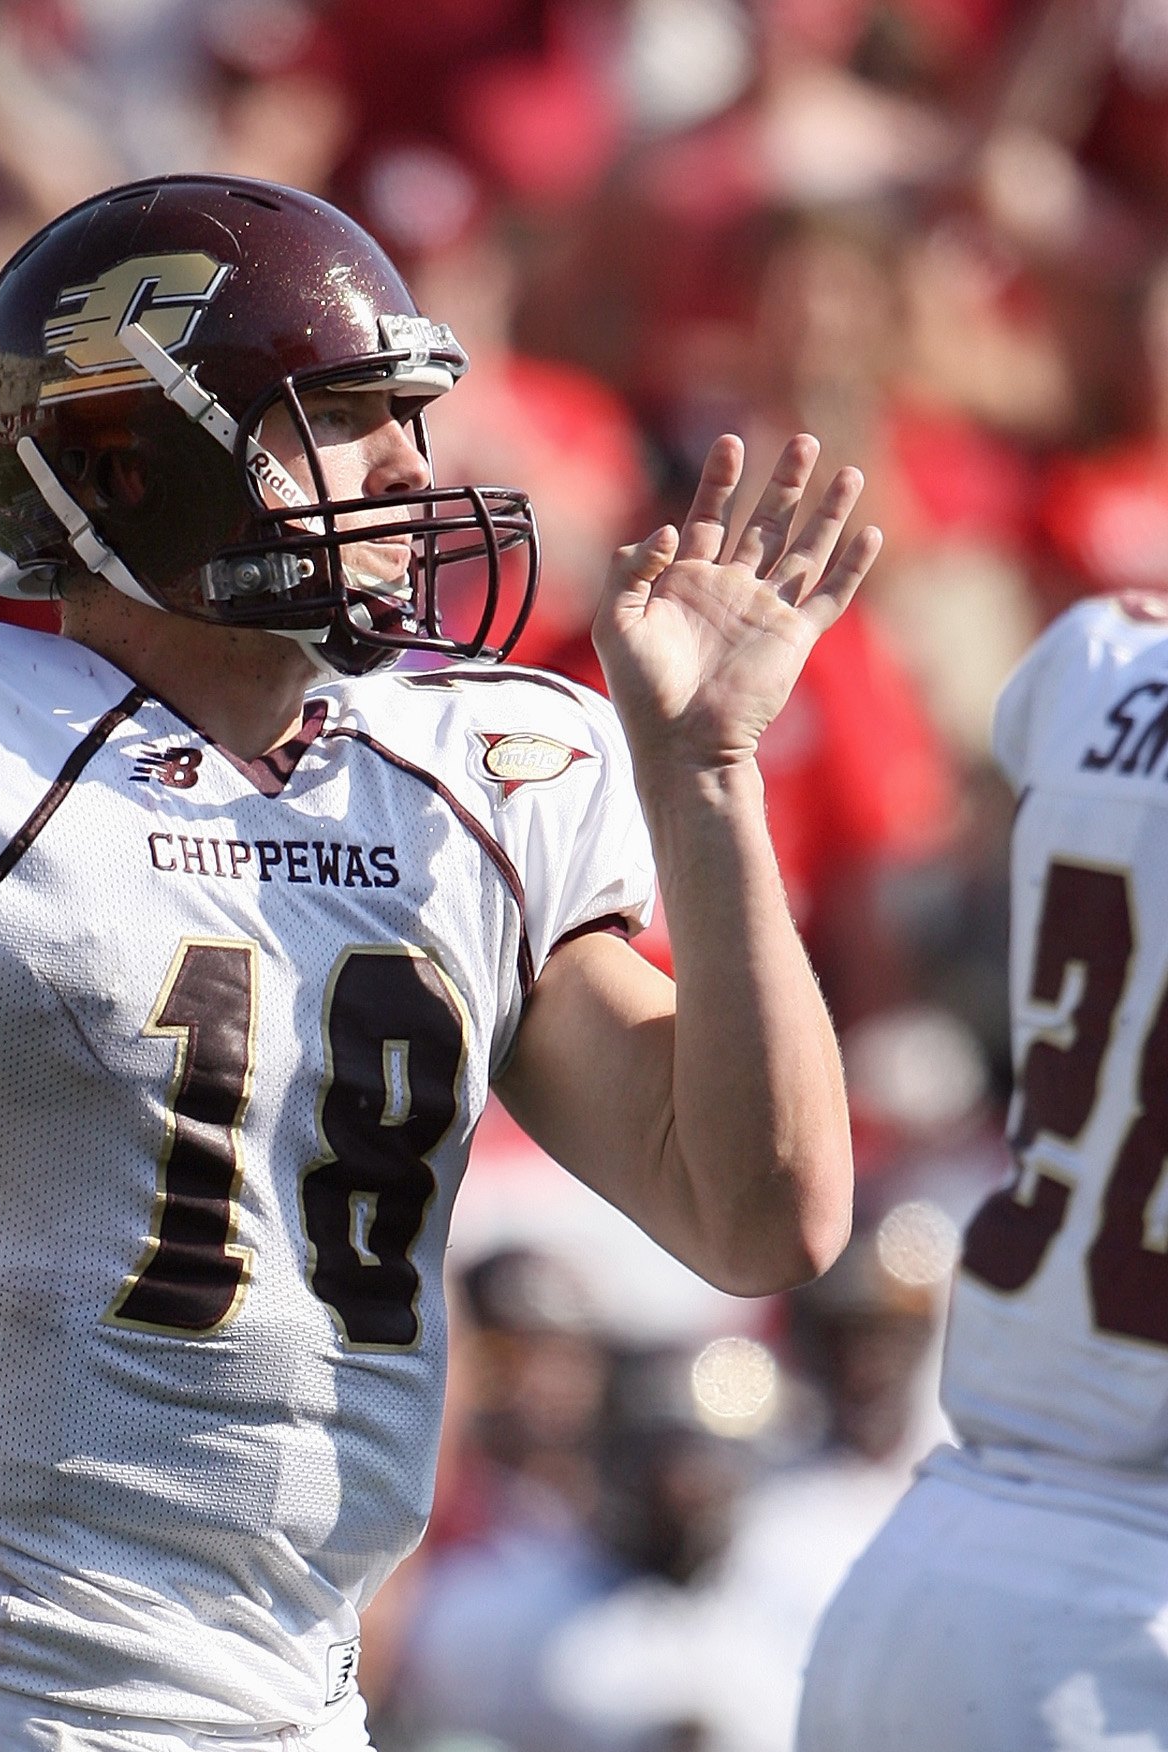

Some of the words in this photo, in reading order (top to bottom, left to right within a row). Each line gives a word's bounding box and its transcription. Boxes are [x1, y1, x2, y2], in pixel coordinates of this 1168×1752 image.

[247, 451, 319, 531] Ridd
[146, 831, 402, 889] CHIPPEWAS
[98, 934, 470, 1353] 18
